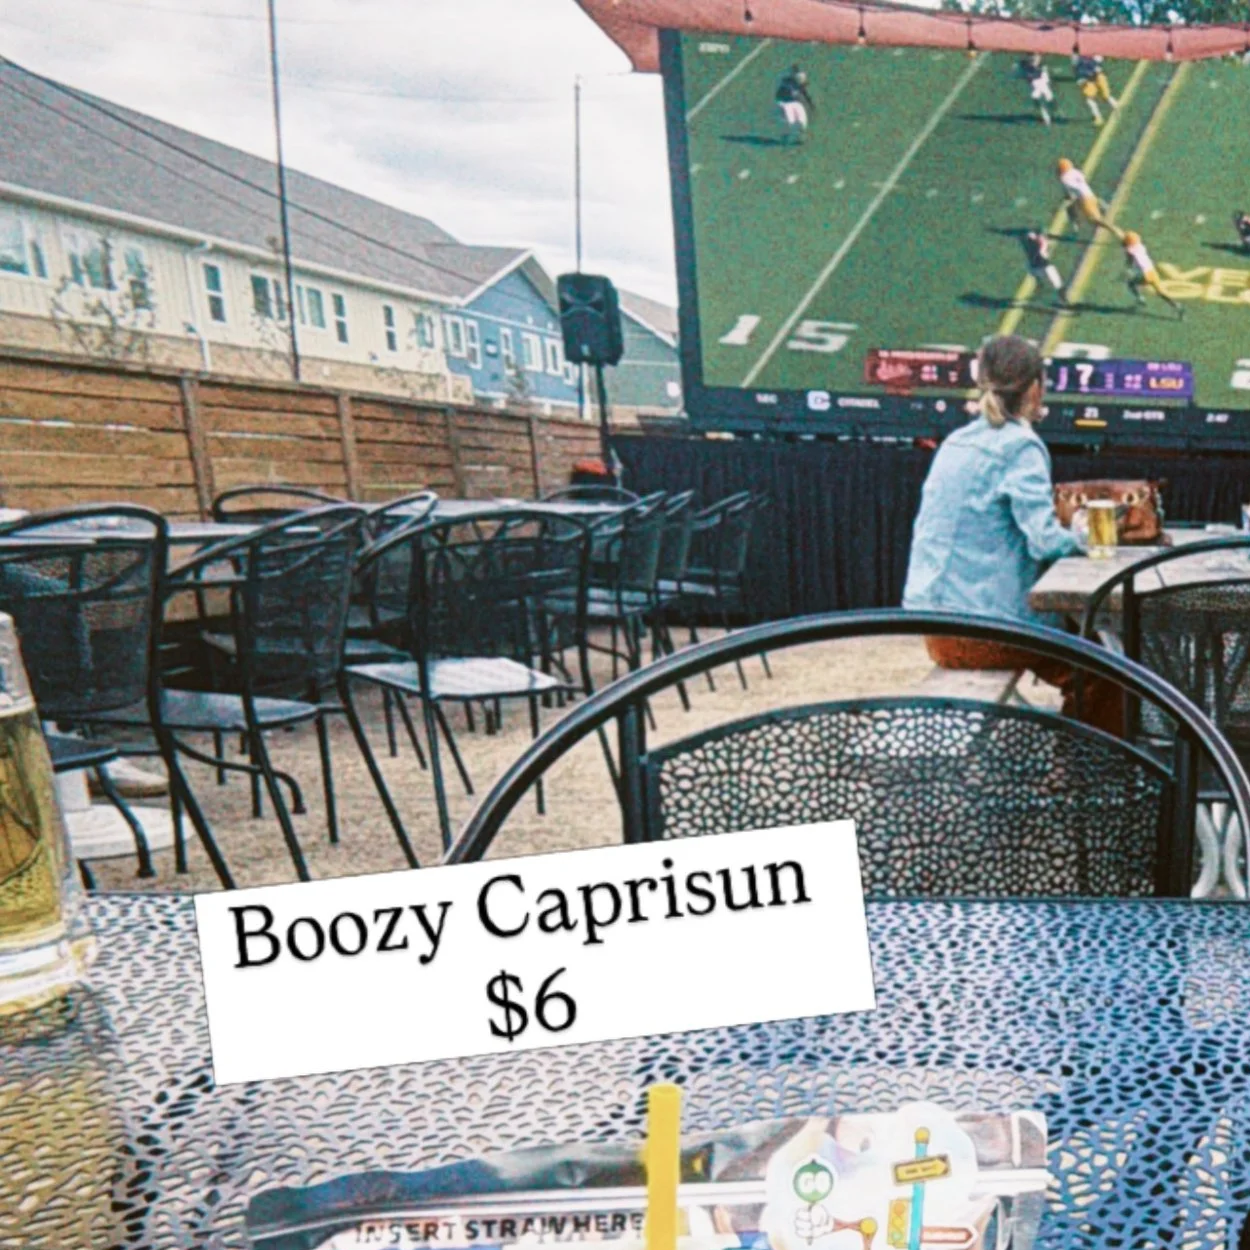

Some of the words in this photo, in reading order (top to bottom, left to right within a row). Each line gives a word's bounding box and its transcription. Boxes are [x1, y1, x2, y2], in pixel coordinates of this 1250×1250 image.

[355, 1221, 457, 1244] INSERT
[464, 1214, 569, 1240] STRAW
[572, 1212, 644, 1235] HERE
